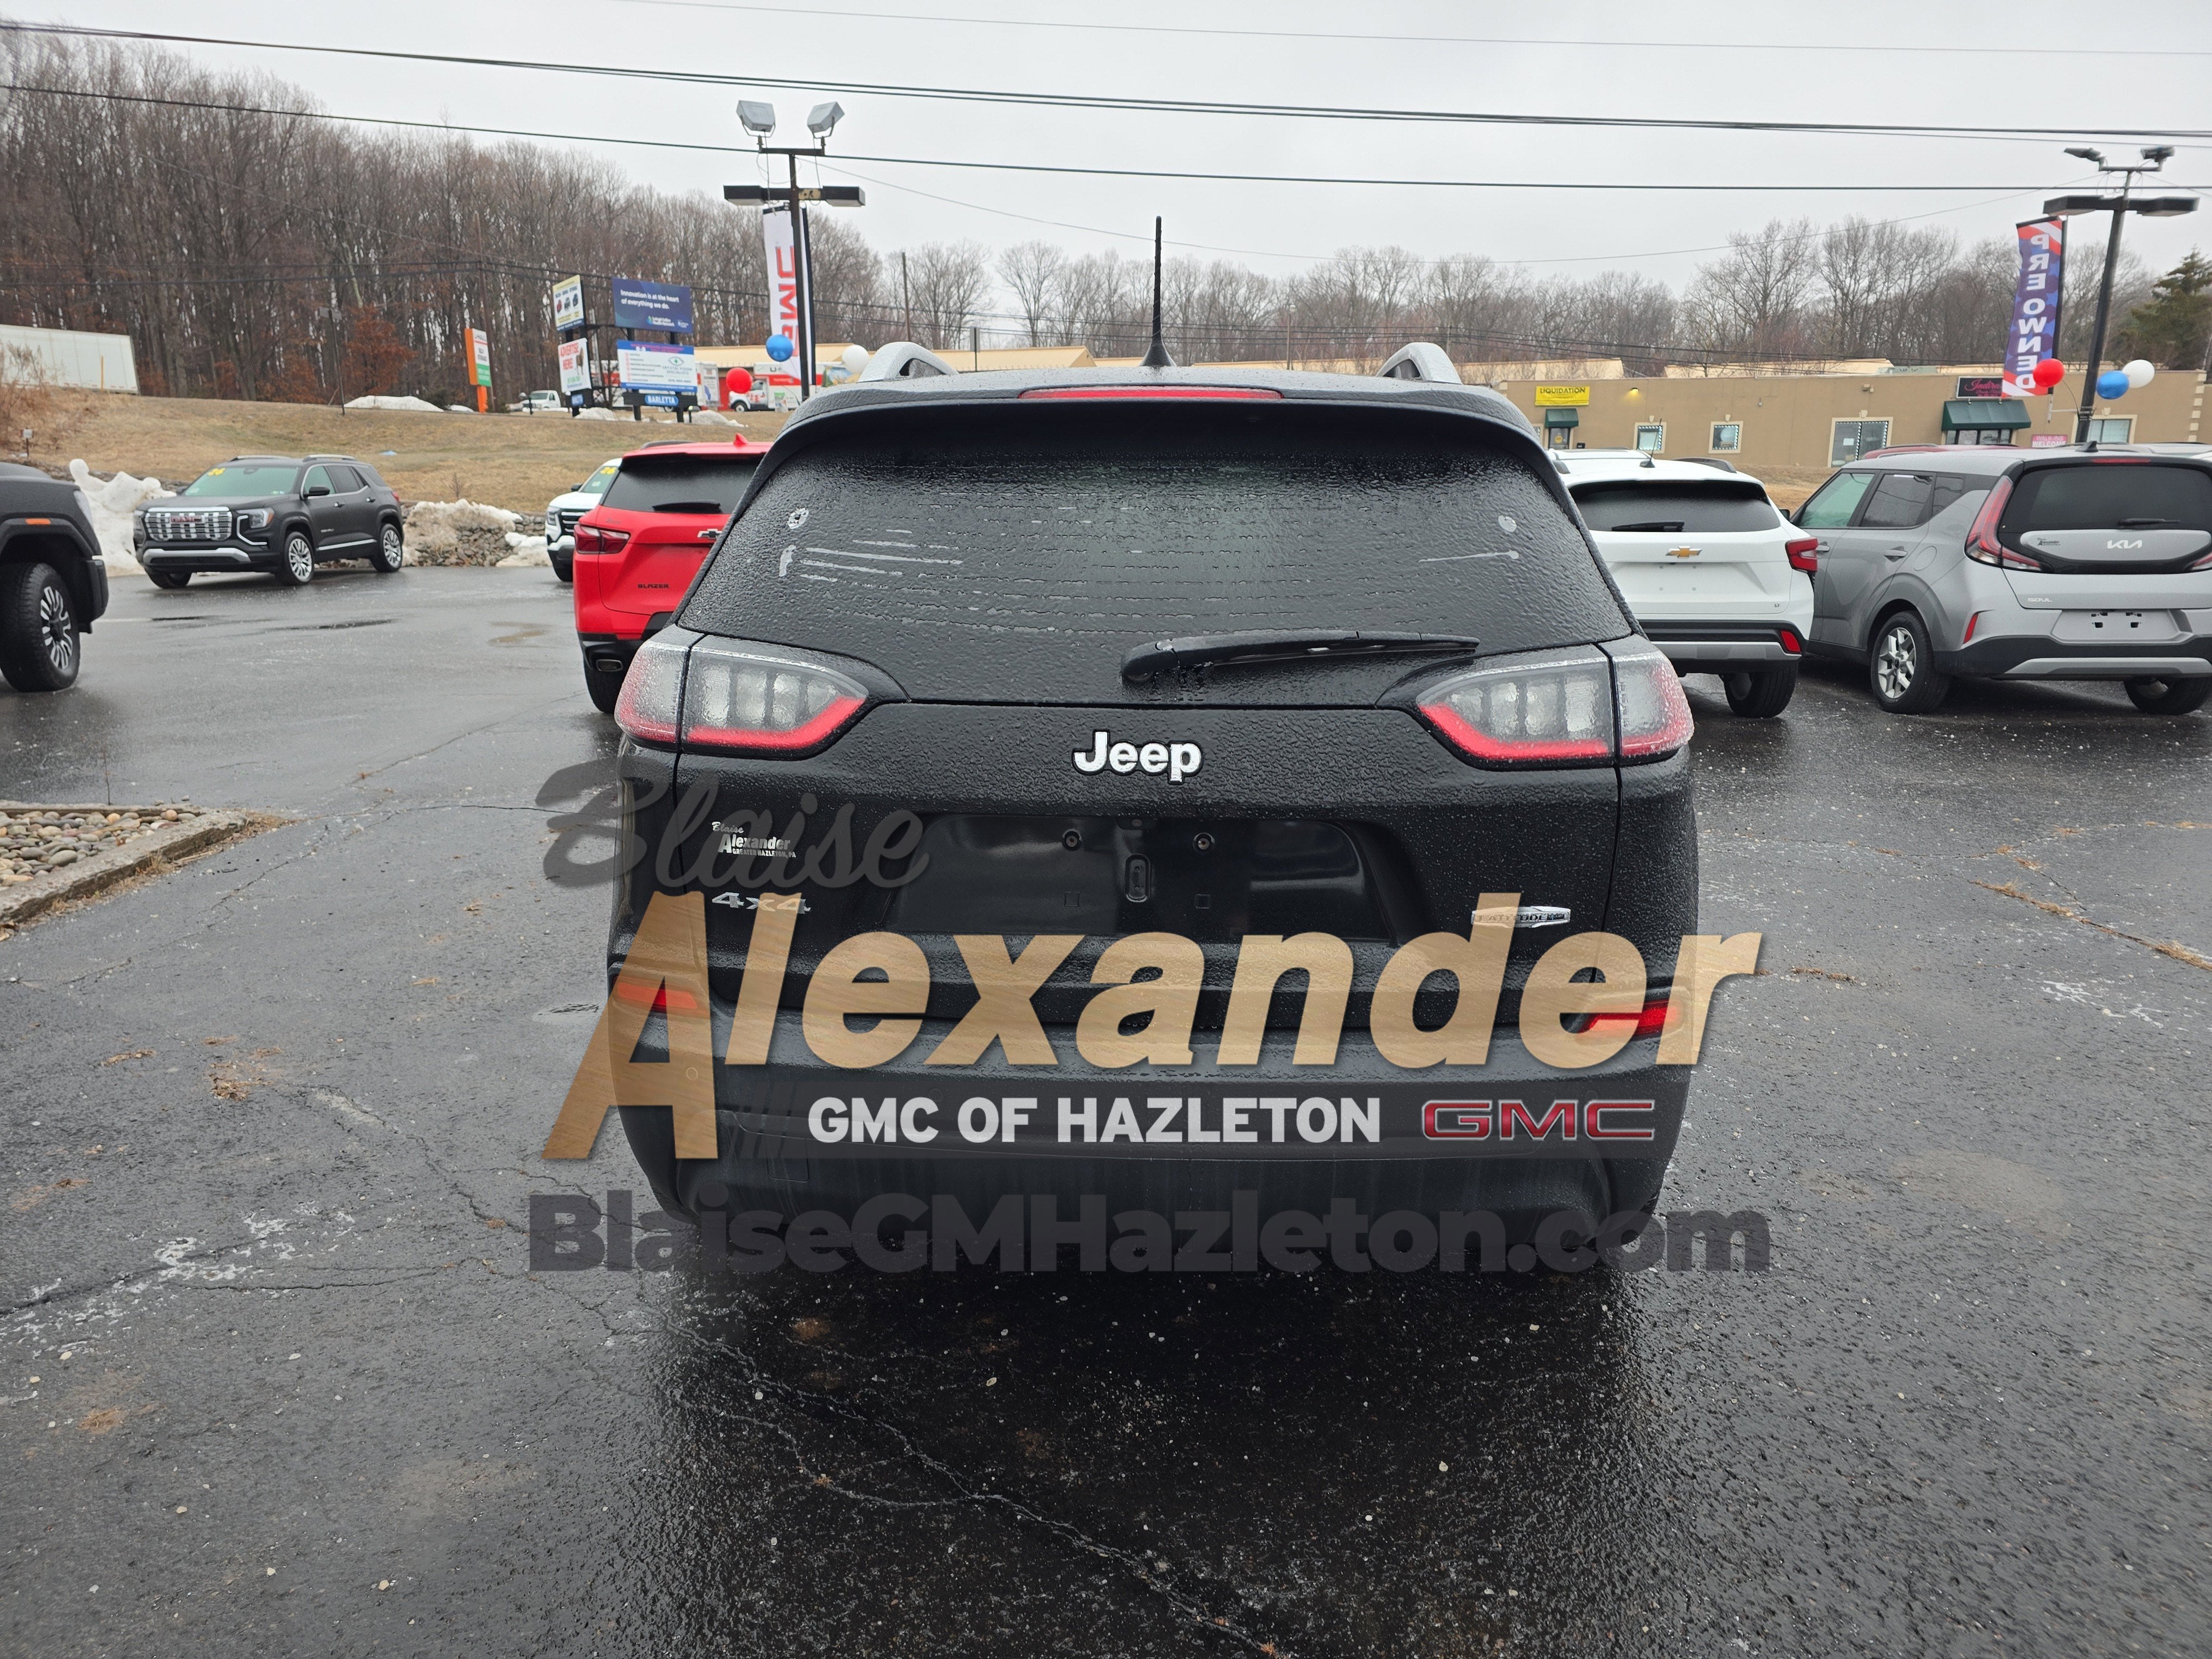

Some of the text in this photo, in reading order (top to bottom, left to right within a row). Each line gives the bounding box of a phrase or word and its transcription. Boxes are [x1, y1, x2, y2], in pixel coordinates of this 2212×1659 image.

[620, 289, 647, 298] Innovation
[627, 299, 653, 309] everything
[648, 395, 676, 403] BARLETTA
[1074, 730, 1203, 783] Jeep
[712, 821, 744, 833] Blaise
[718, 834, 791, 853] Alexander
[732, 848, 757, 856] GREATER
